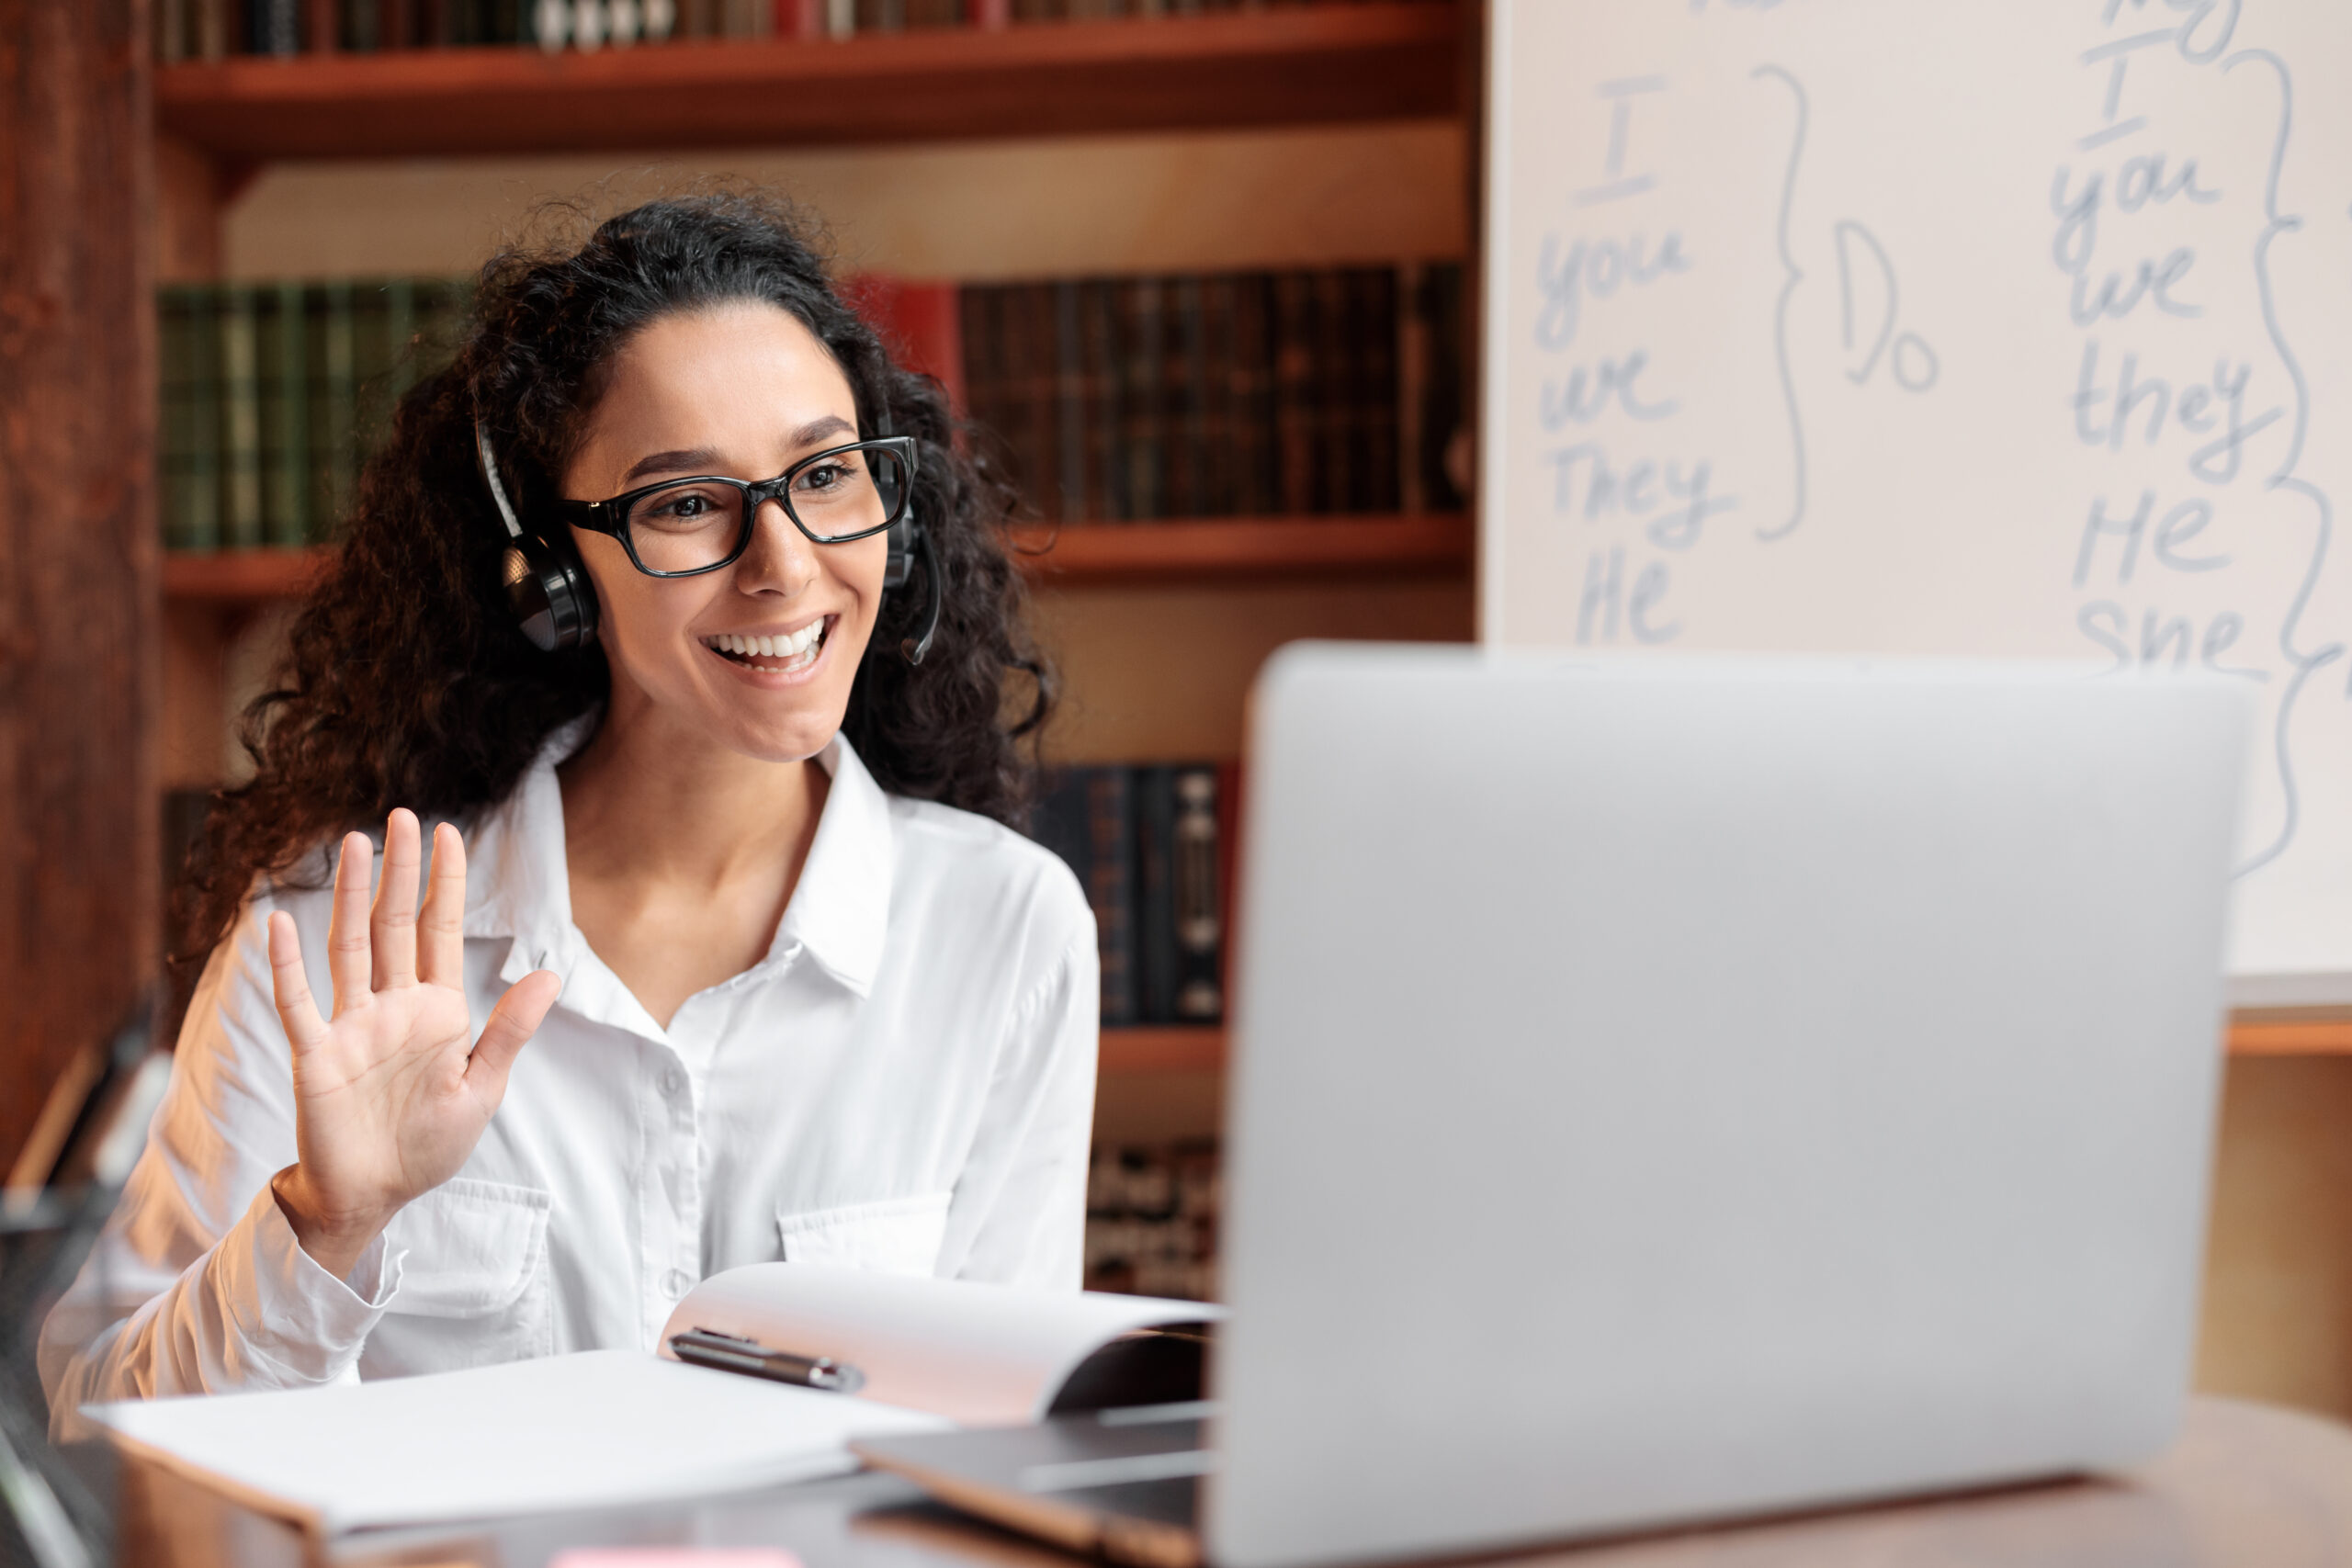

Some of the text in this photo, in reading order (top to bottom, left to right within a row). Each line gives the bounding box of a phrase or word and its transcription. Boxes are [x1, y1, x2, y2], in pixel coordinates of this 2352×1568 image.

[1568, 74, 1670, 209] I
[1534, 230, 1694, 353] you
[2069, 337, 2286, 485] they
[1543, 442, 1740, 551] They
[2072, 488, 2233, 589] He
[1575, 543, 1682, 646] He
